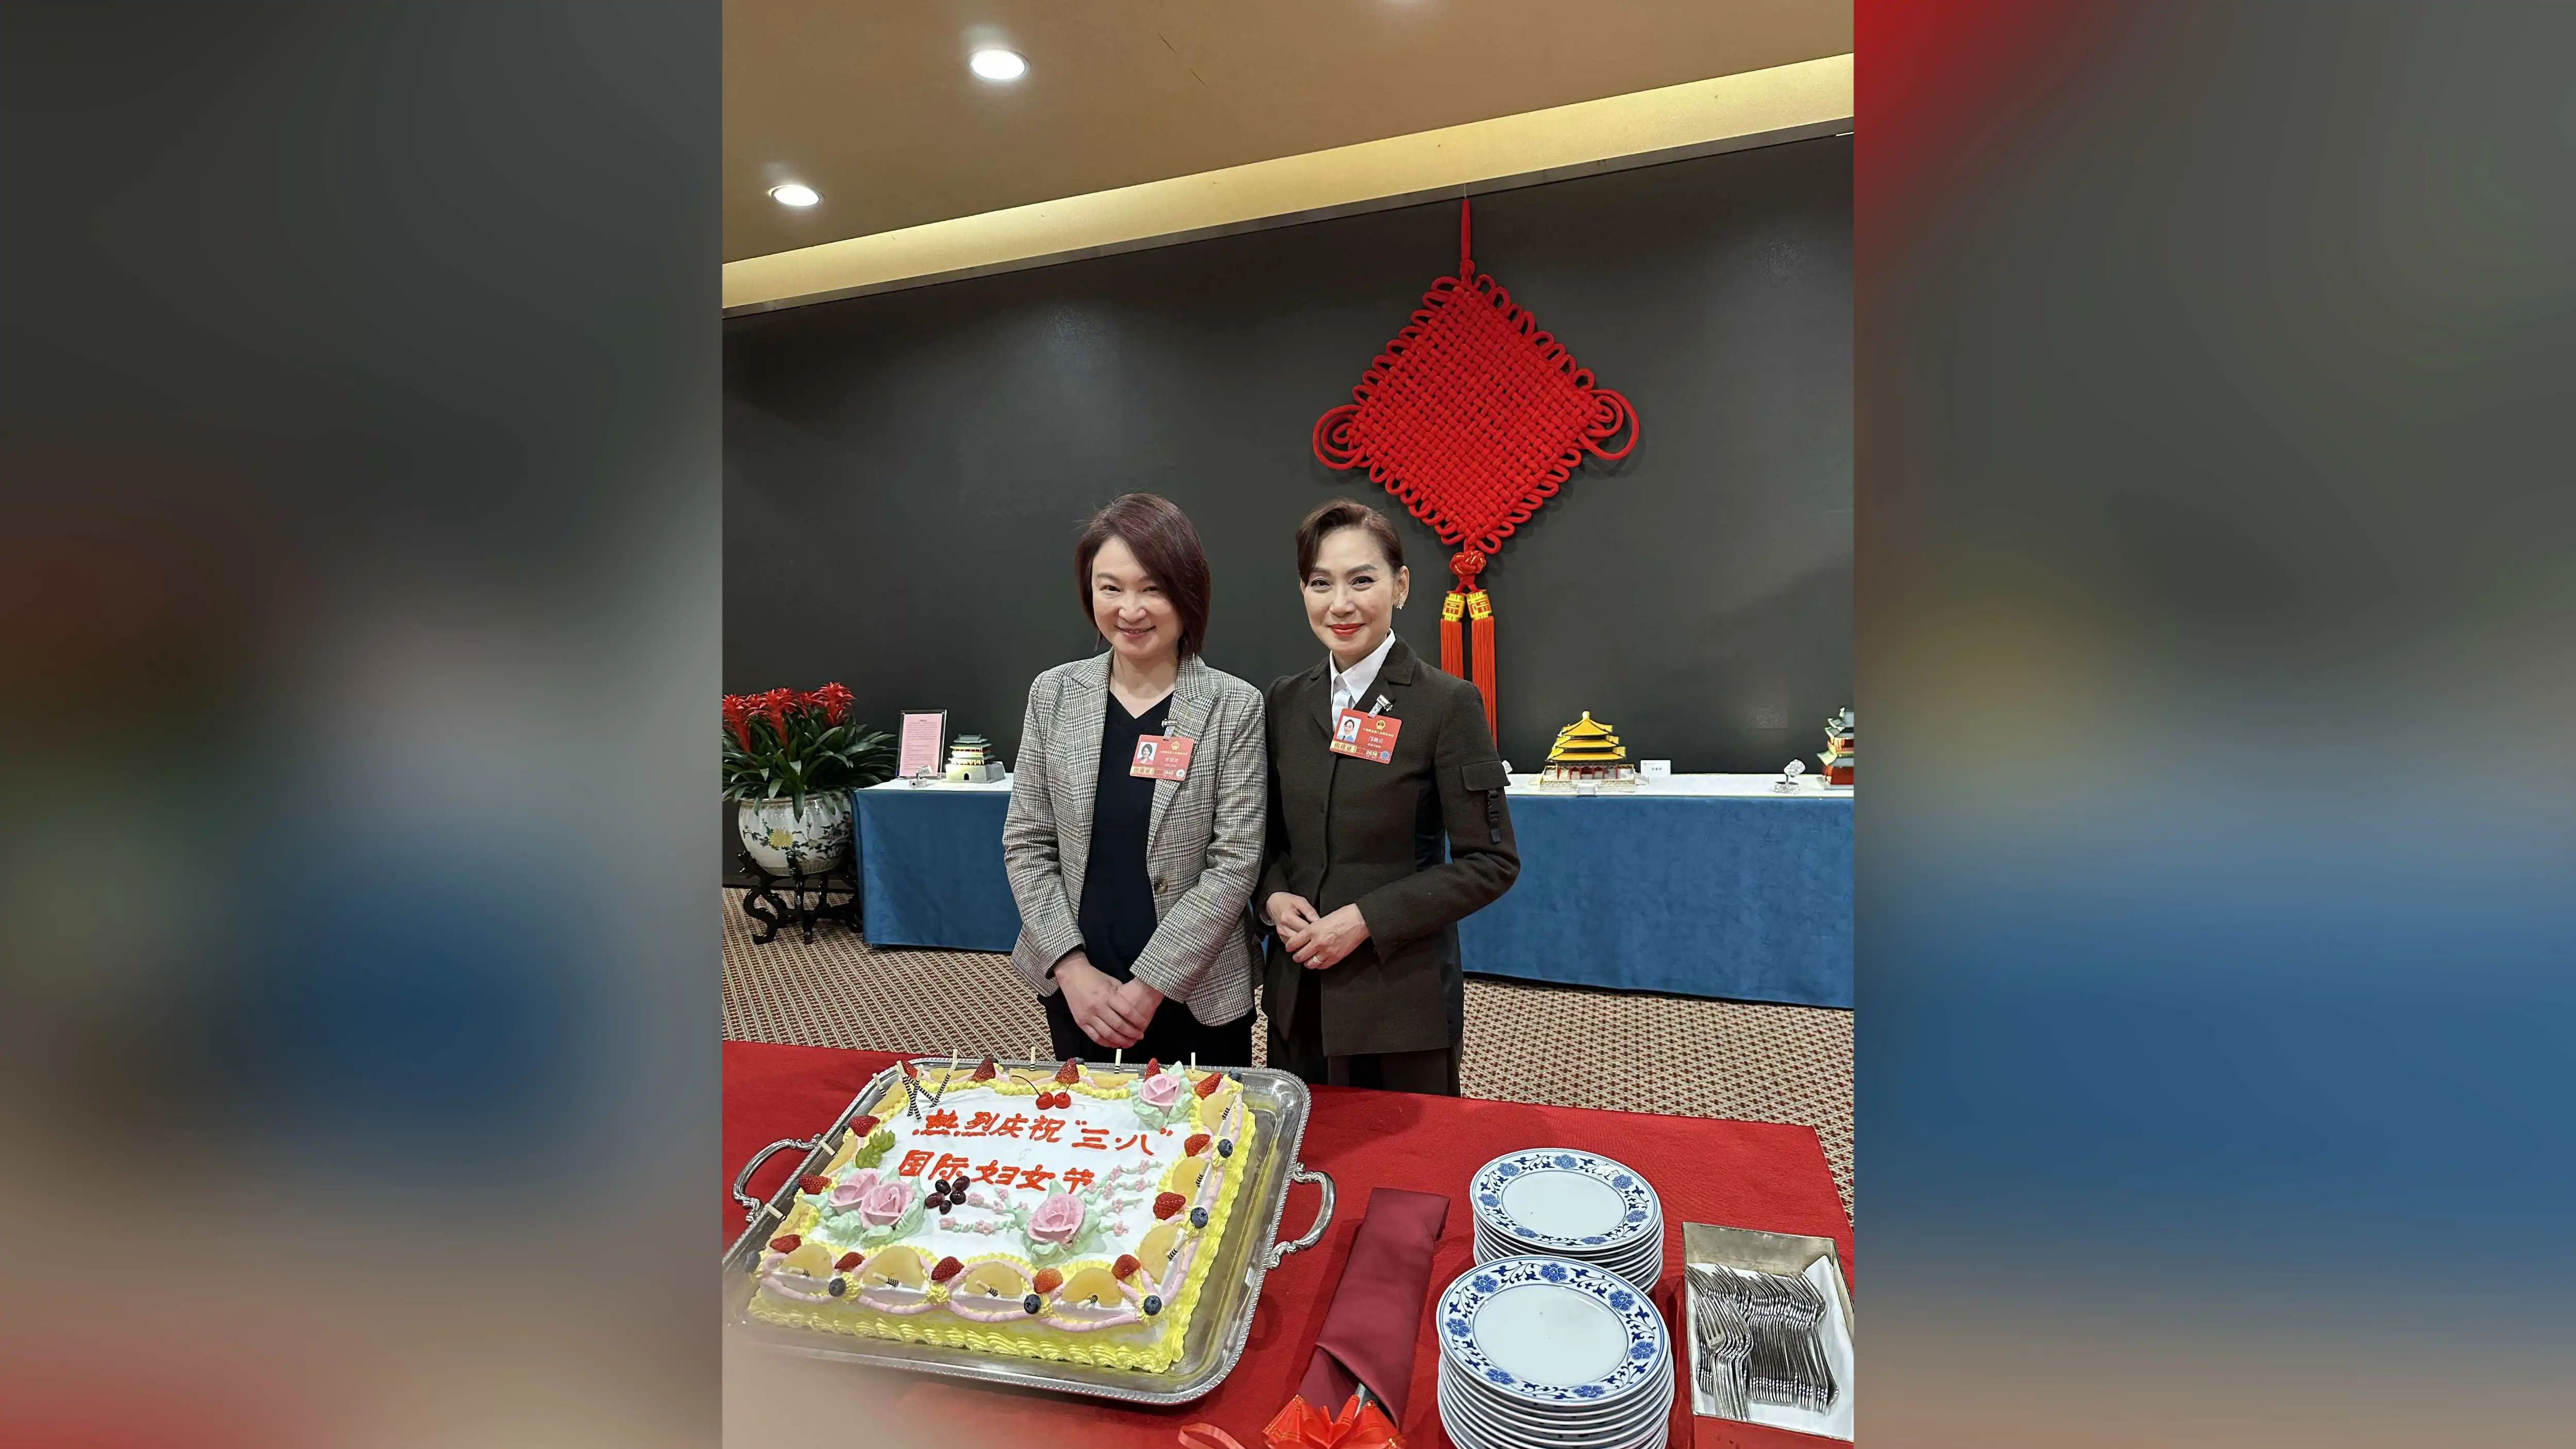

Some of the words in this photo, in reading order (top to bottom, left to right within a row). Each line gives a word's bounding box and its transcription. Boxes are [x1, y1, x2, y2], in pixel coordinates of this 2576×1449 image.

[898, 1149, 1095, 1194] 国际妇女节
